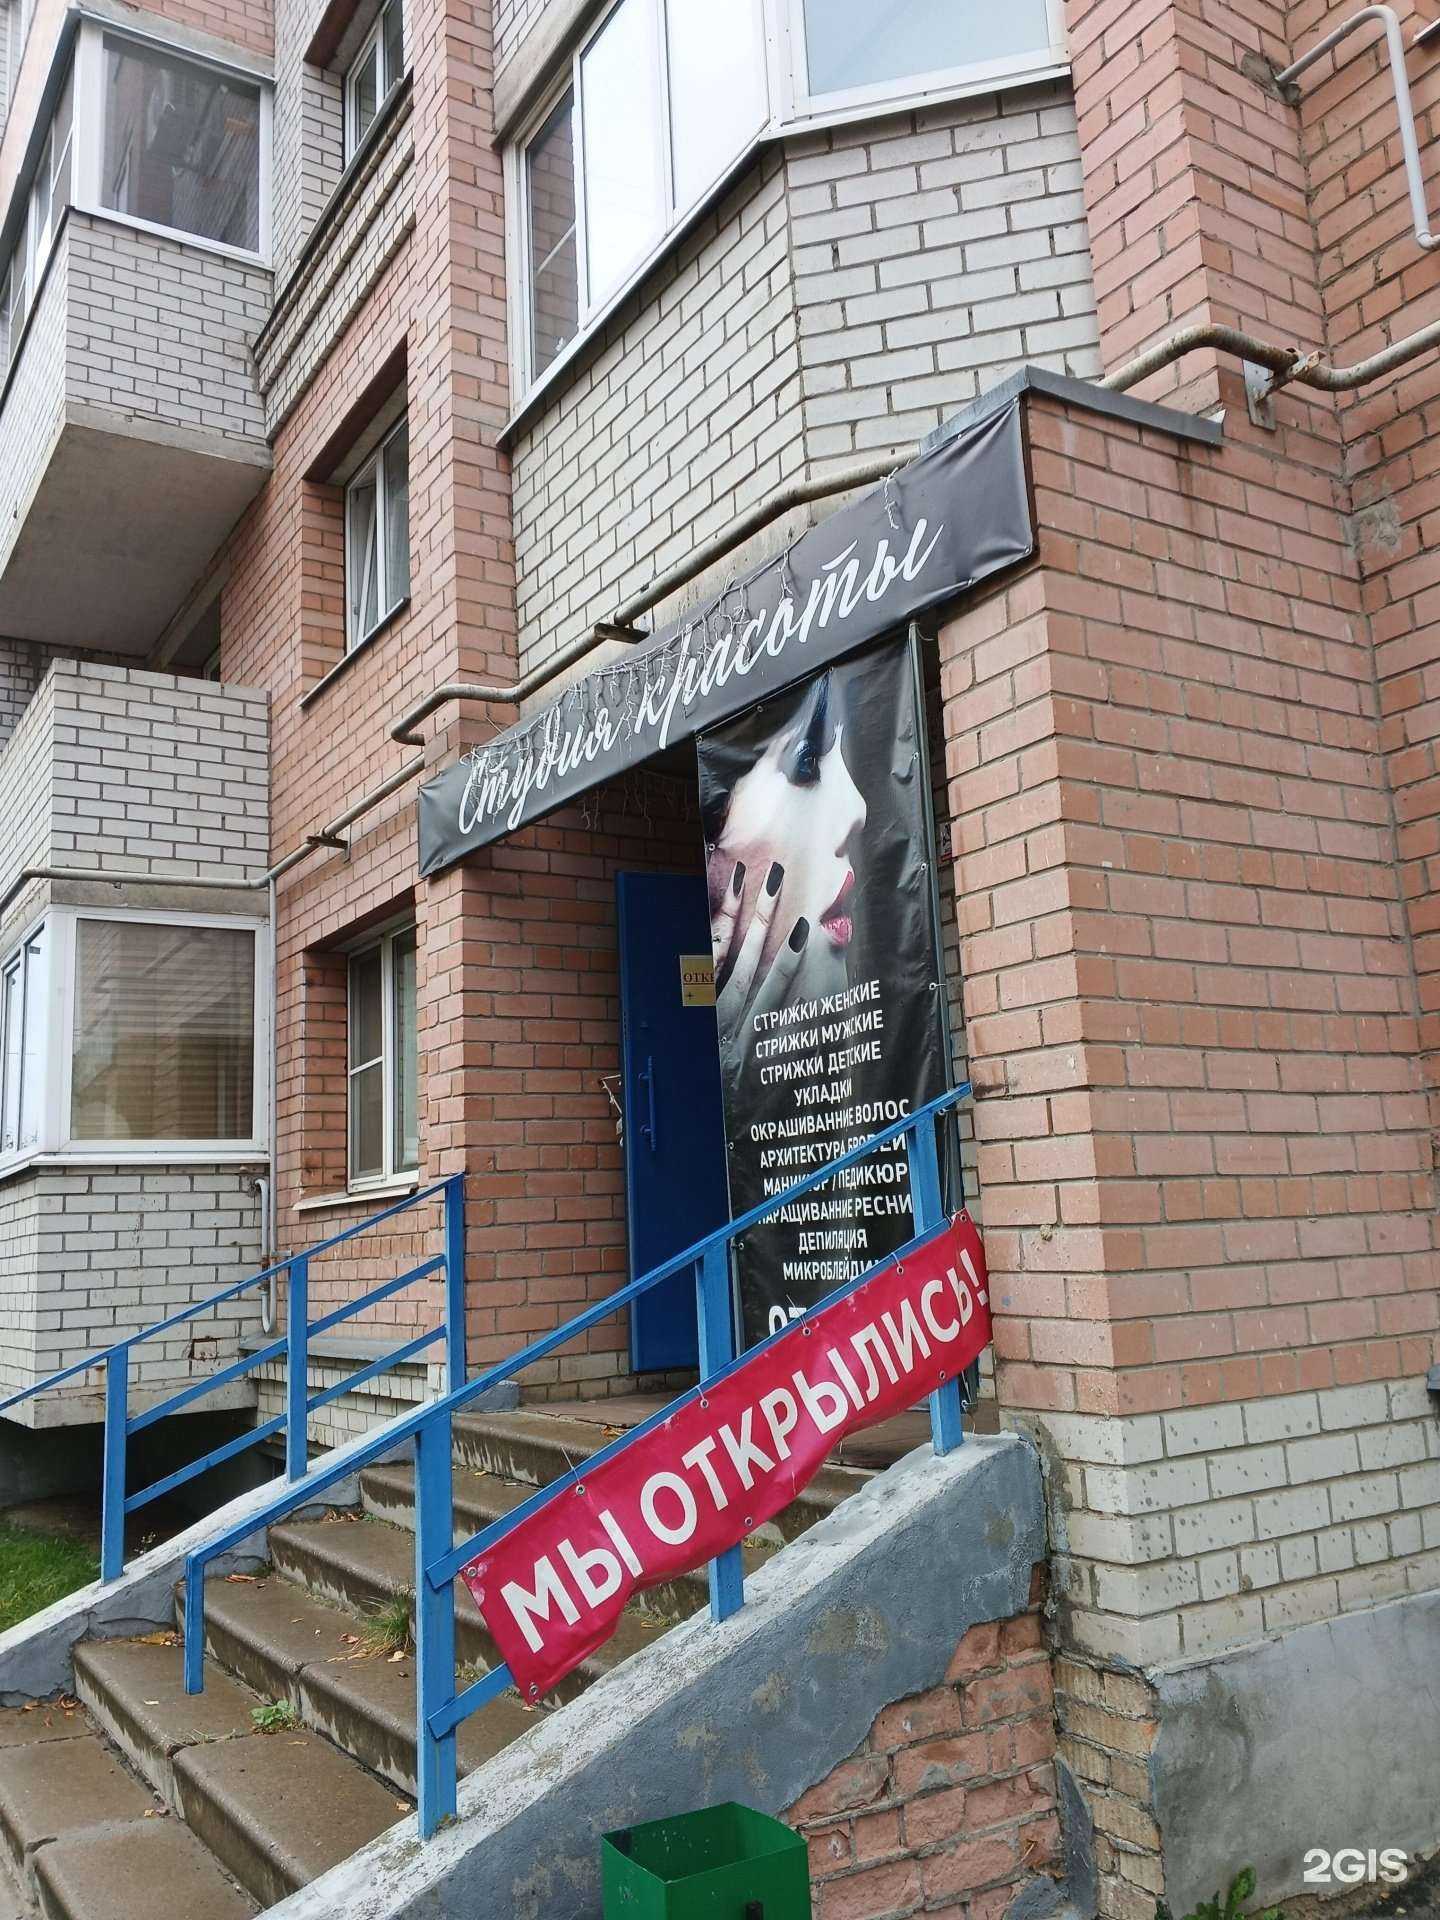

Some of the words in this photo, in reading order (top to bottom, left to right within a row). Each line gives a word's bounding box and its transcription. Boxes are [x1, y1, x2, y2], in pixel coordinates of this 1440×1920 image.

[458, 703, 624, 835] Студия
[634, 518, 944, 749] красоты
[753, 1000, 818, 1032] СТРИЖКИ
[820, 979, 881, 1016] ЖЕНСКИЕ
[755, 1028, 819, 1058] СТРИЖКИ
[821, 1009, 884, 1044] МУЖСКИЕ
[760, 1056, 824, 1085] СТРИЖКИ
[828, 1040, 882, 1076] ДЕТСКИЕ
[793, 1078, 852, 1107] УКЛАДКИ
[750, 1107, 853, 1142] ОКРАШИВАННИЕ
[855, 1098, 911, 1124] ВОЛОС
[760, 1138, 846, 1169] АРХИТЕКТУРА
[763, 1173, 829, 1197] МАНИР
[838, 1162, 908, 1191] ПЕДИКЮР
[758, 1199, 853, 1226] АРАЩИВАННИЕ
[798, 1228, 868, 1255] ДЕПИЛЯЦИЯ
[783, 1256, 880, 1282] МИКРОБЛЕЙДИ
[500, 1511, 643, 1653] МЫ
[640, 1248, 988, 1546] ОТКРЫЛИСЬ!
